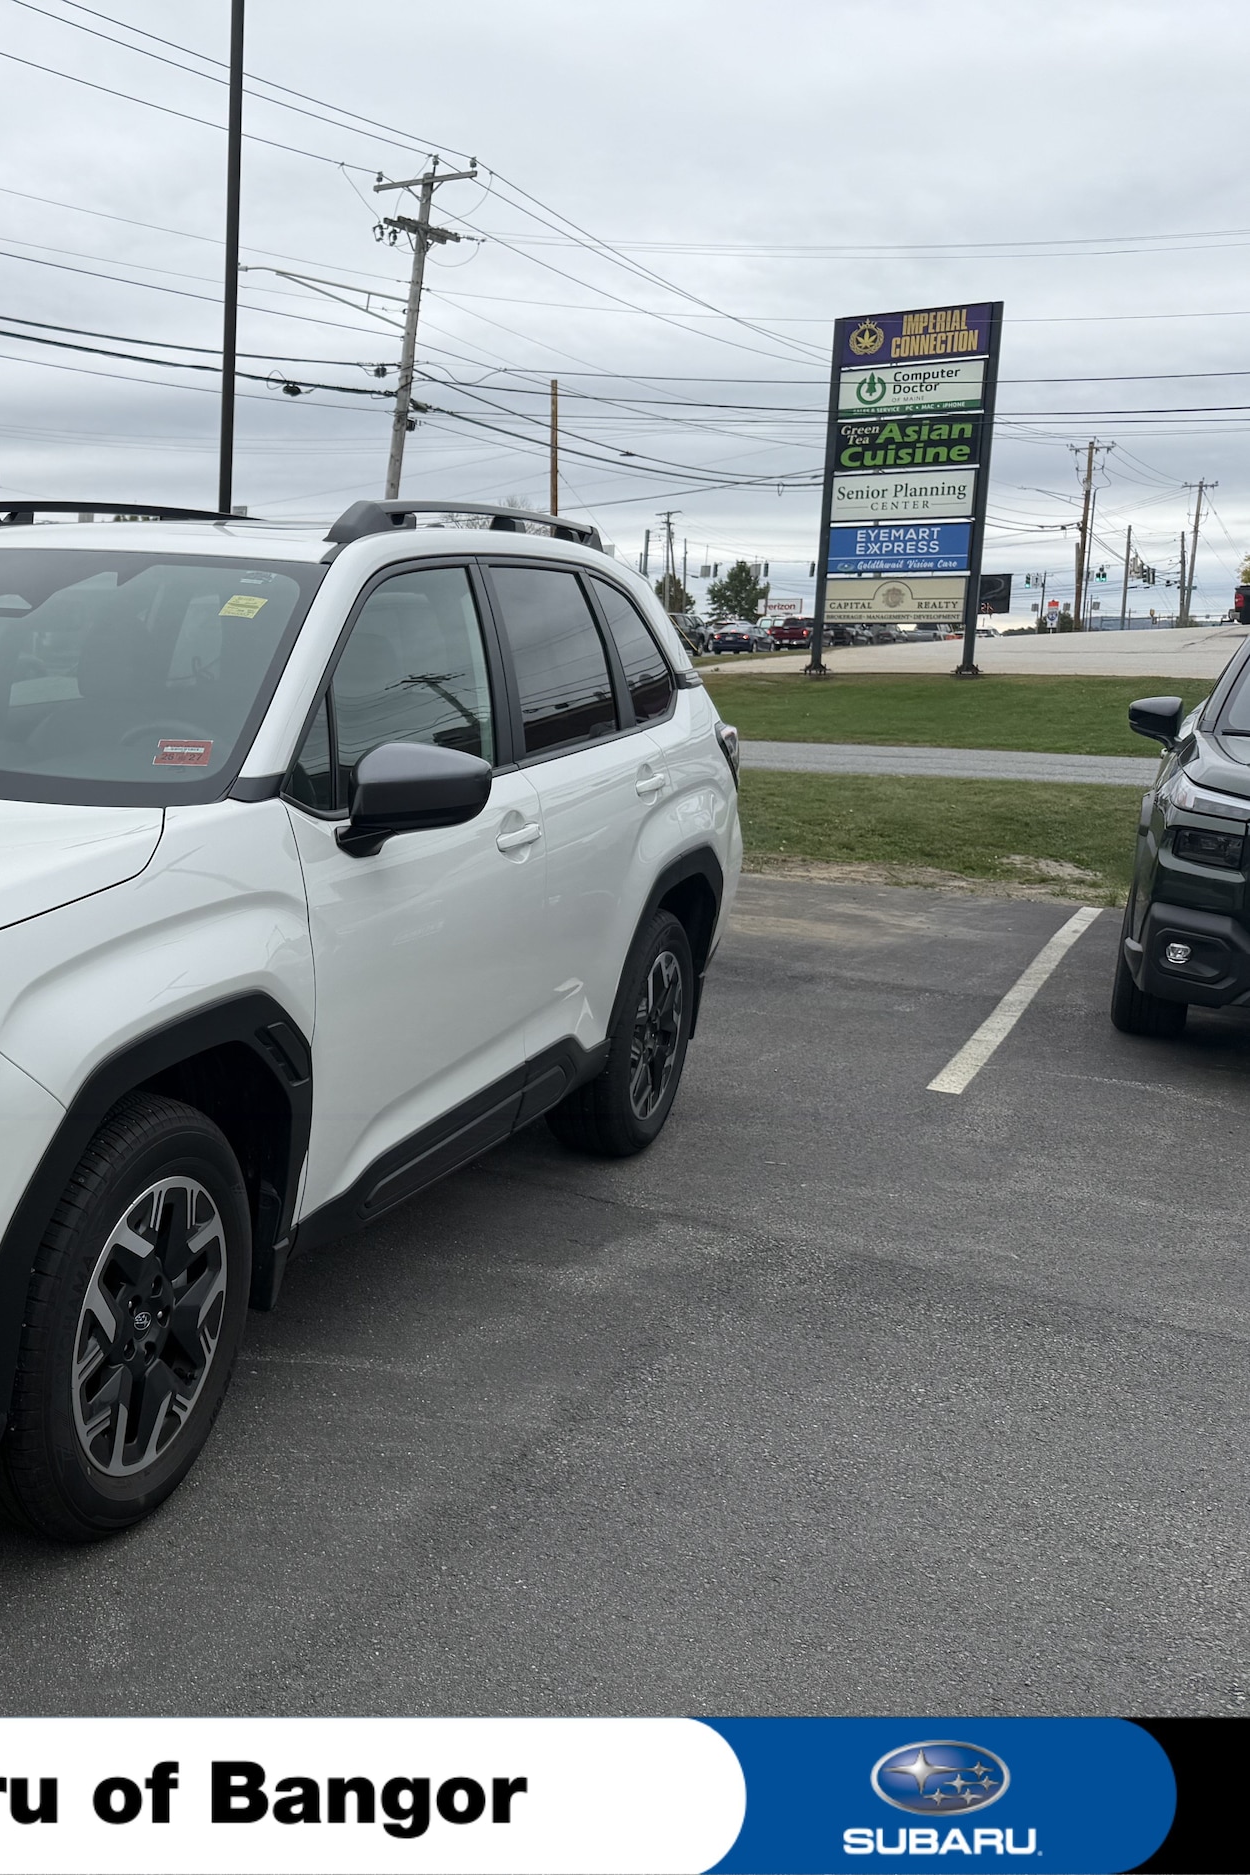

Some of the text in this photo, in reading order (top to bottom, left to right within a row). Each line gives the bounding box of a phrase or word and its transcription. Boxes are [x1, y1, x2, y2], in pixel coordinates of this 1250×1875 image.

[902, 309, 968, 336] IMPERIAL
[891, 330, 979, 358] CONNECTION
[893, 368, 961, 383] Computer
[892, 382, 940, 395] Doctor
[840, 420, 973, 444] Green Asian
[847, 435, 870, 445] Tea
[840, 443, 971, 468] Cuisine
[837, 482, 967, 500] Senior Planning
[870, 500, 930, 511] CENTER
[857, 527, 941, 542] EYEMART
[856, 541, 940, 555] EXPRESS
[907, 559, 934, 569] Vision
[937, 560, 958, 568] Care
[829, 601, 959, 610] CAPITAL REALTY
